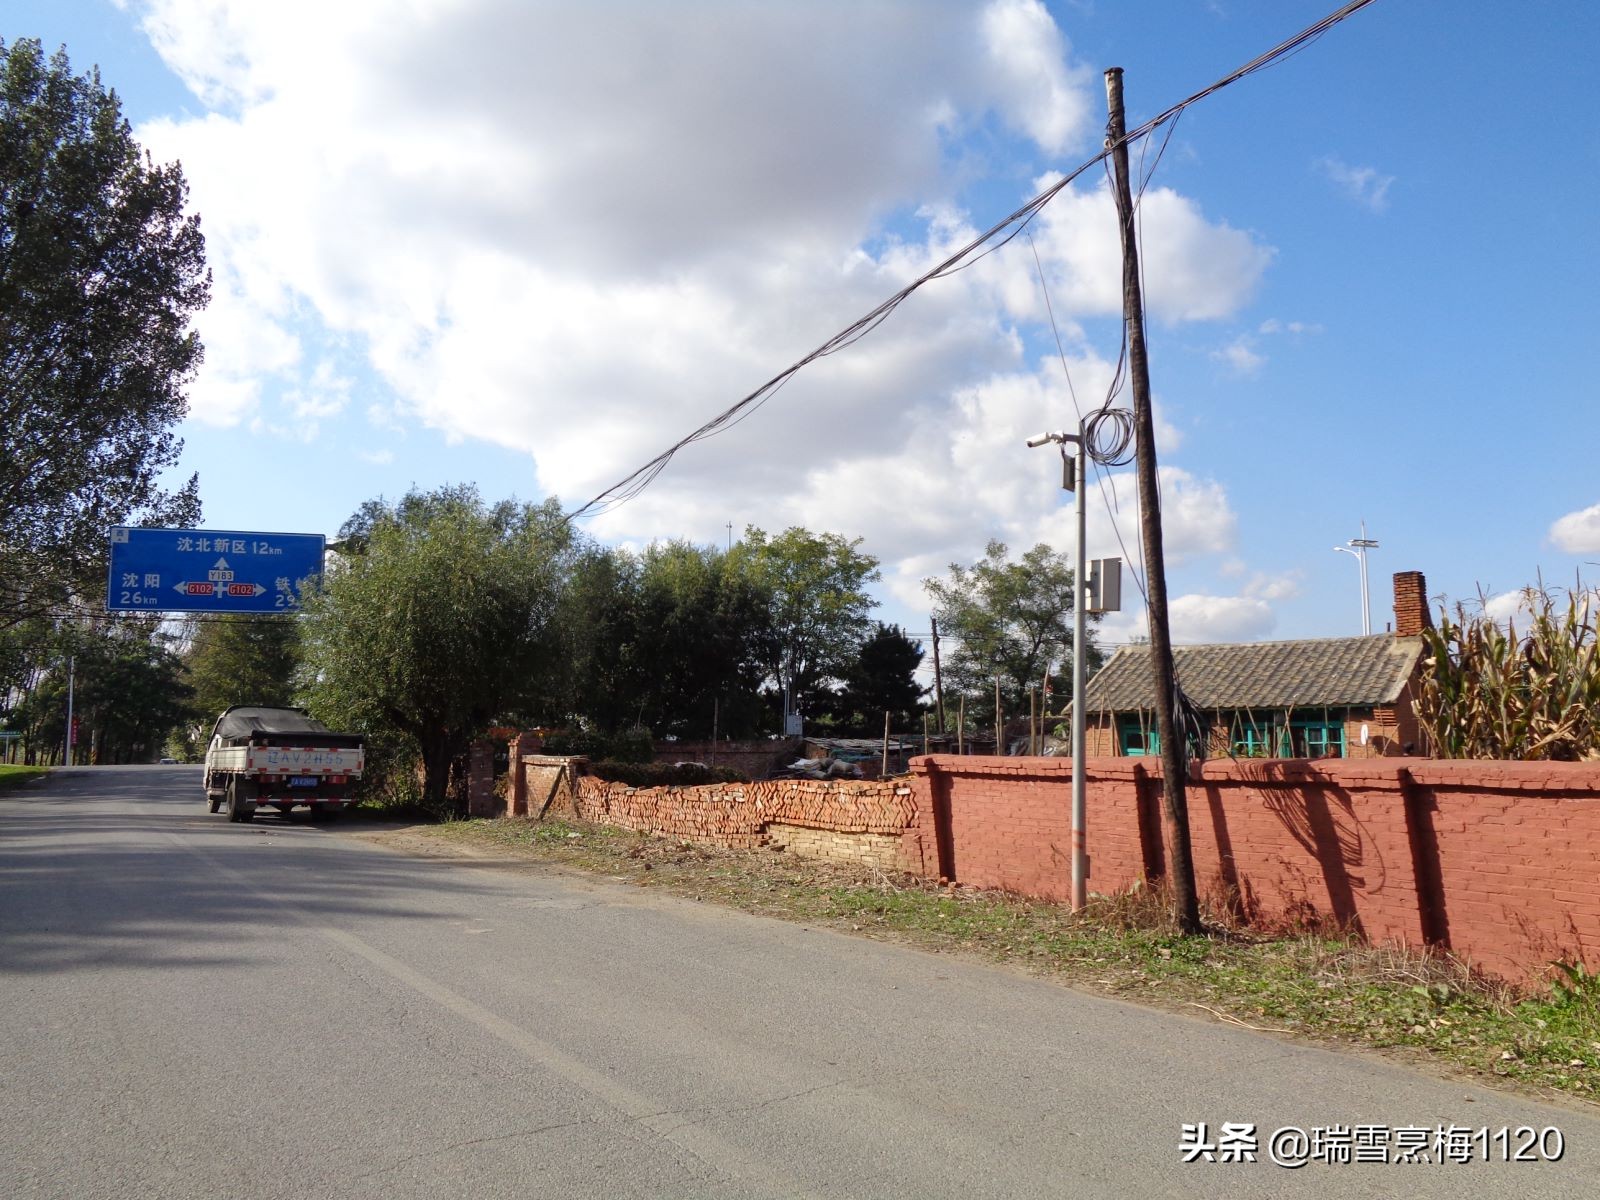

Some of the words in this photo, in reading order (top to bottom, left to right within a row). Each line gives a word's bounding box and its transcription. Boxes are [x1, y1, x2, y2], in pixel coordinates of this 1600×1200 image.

[177, 537, 246, 553] 沈北新区
[252, 541, 283, 555] 12km
[122, 573, 160, 588] 沈阳
[210, 571, 233, 581] Y183
[188, 583, 212, 593] G102
[229, 584, 252, 594] G102
[120, 591, 157, 604] 26km
